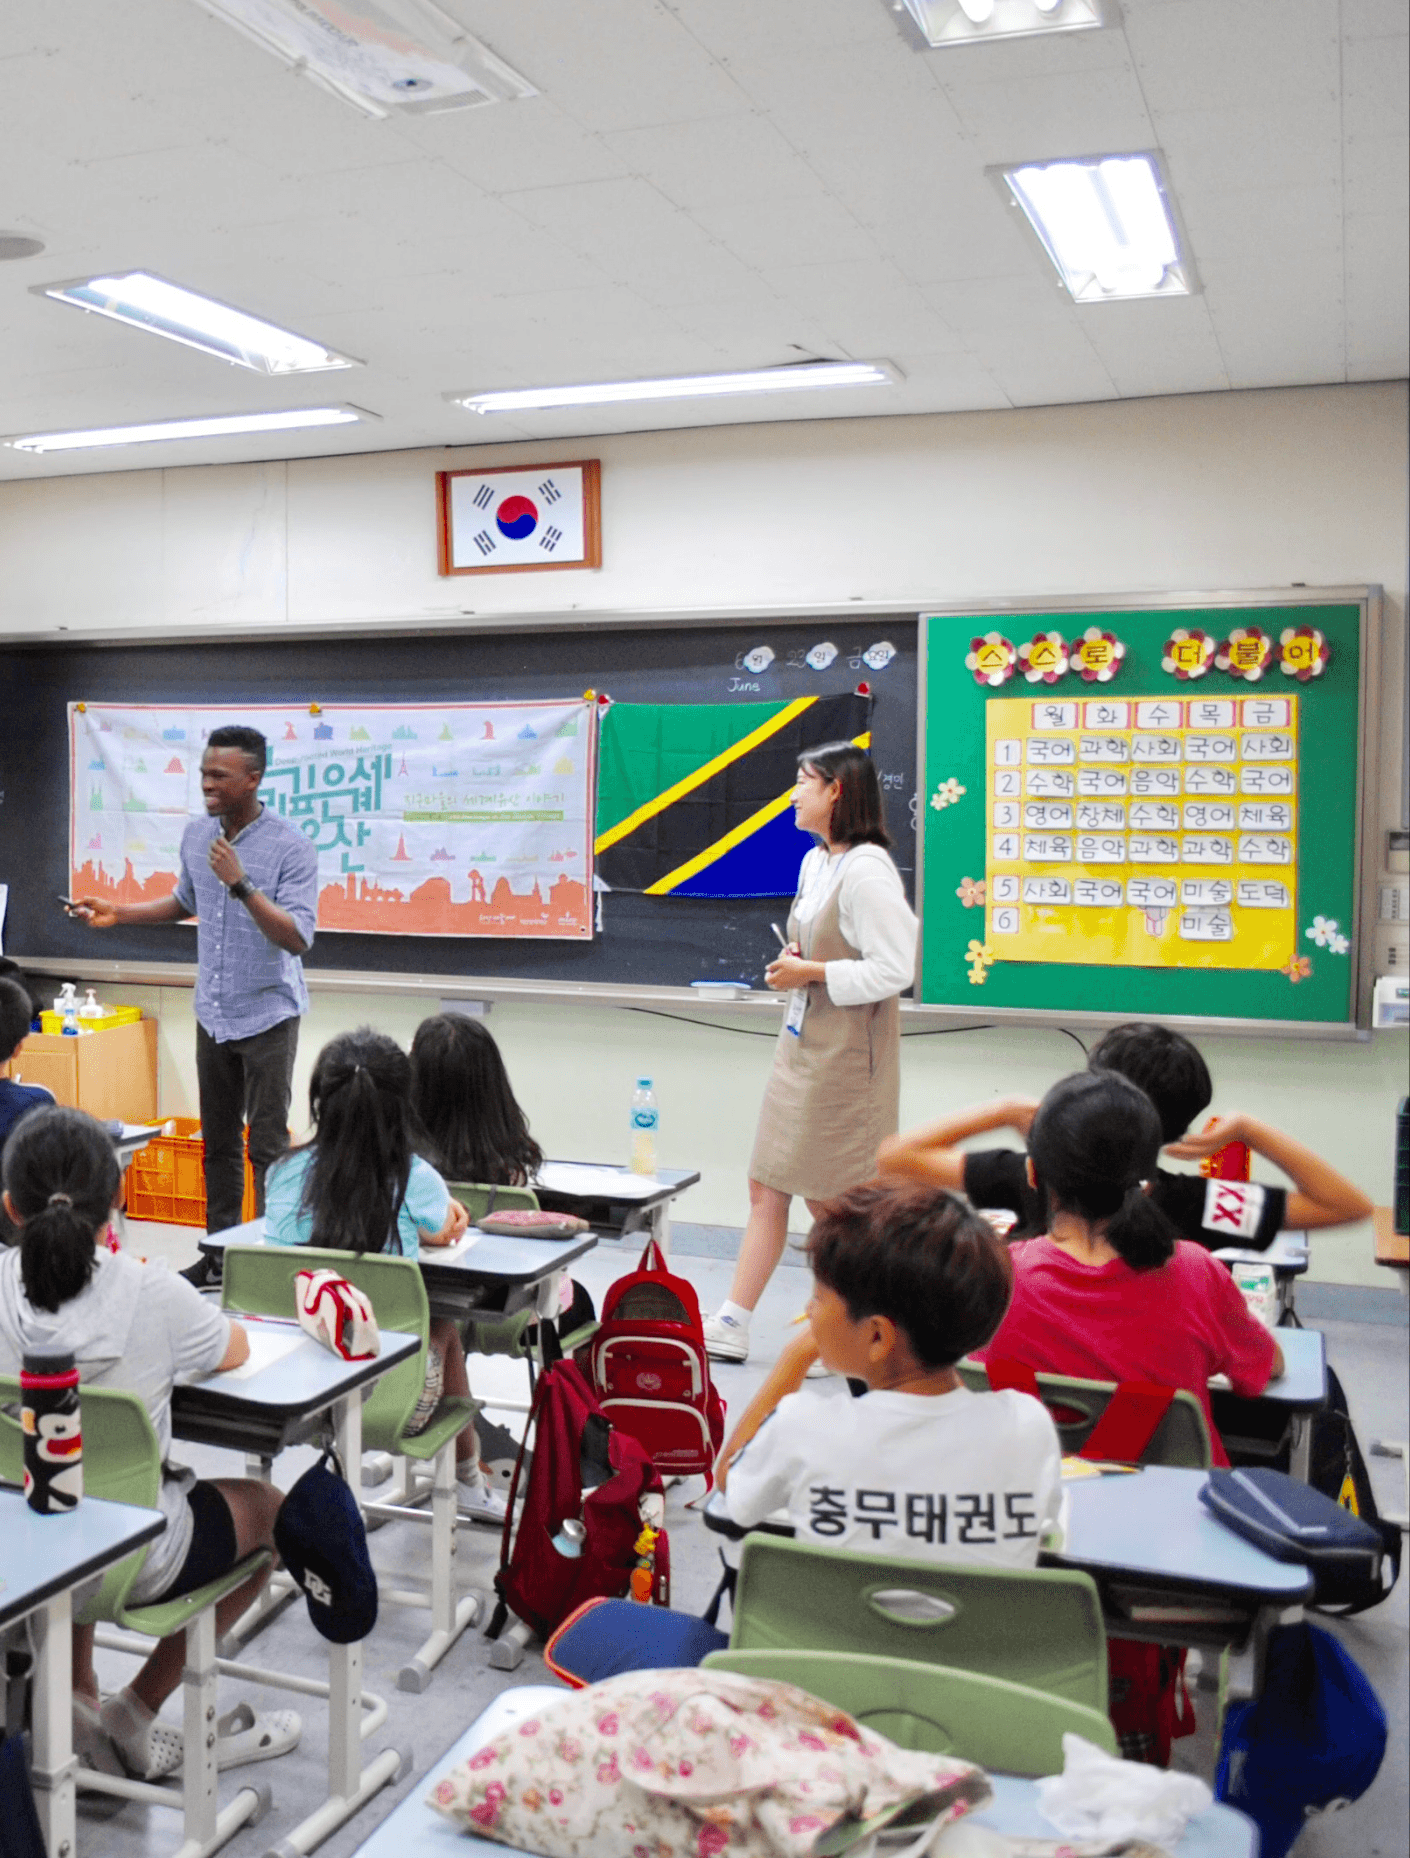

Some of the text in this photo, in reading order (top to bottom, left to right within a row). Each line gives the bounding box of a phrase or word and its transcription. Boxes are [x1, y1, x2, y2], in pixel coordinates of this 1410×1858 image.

[728, 677, 760, 692] June
[1044, 702, 1275, 727] 월 화 수 목 금
[1004, 736, 1290, 762] 1 국어 과학 사회 국어 사회
[1001, 769, 1289, 794] 2 수학 국어 음악 수학 국어
[1001, 805, 1288, 827] 3 영어 창체 수학 영어 체육
[999, 836, 1288, 861] 4 체육 음악 과학 과학 수학
[999, 878, 1285, 905] 5 사회 국어 국어 미술 도덕
[998, 911, 1229, 937] 6 미술
[809, 1486, 1039, 1545] 충무태권도
